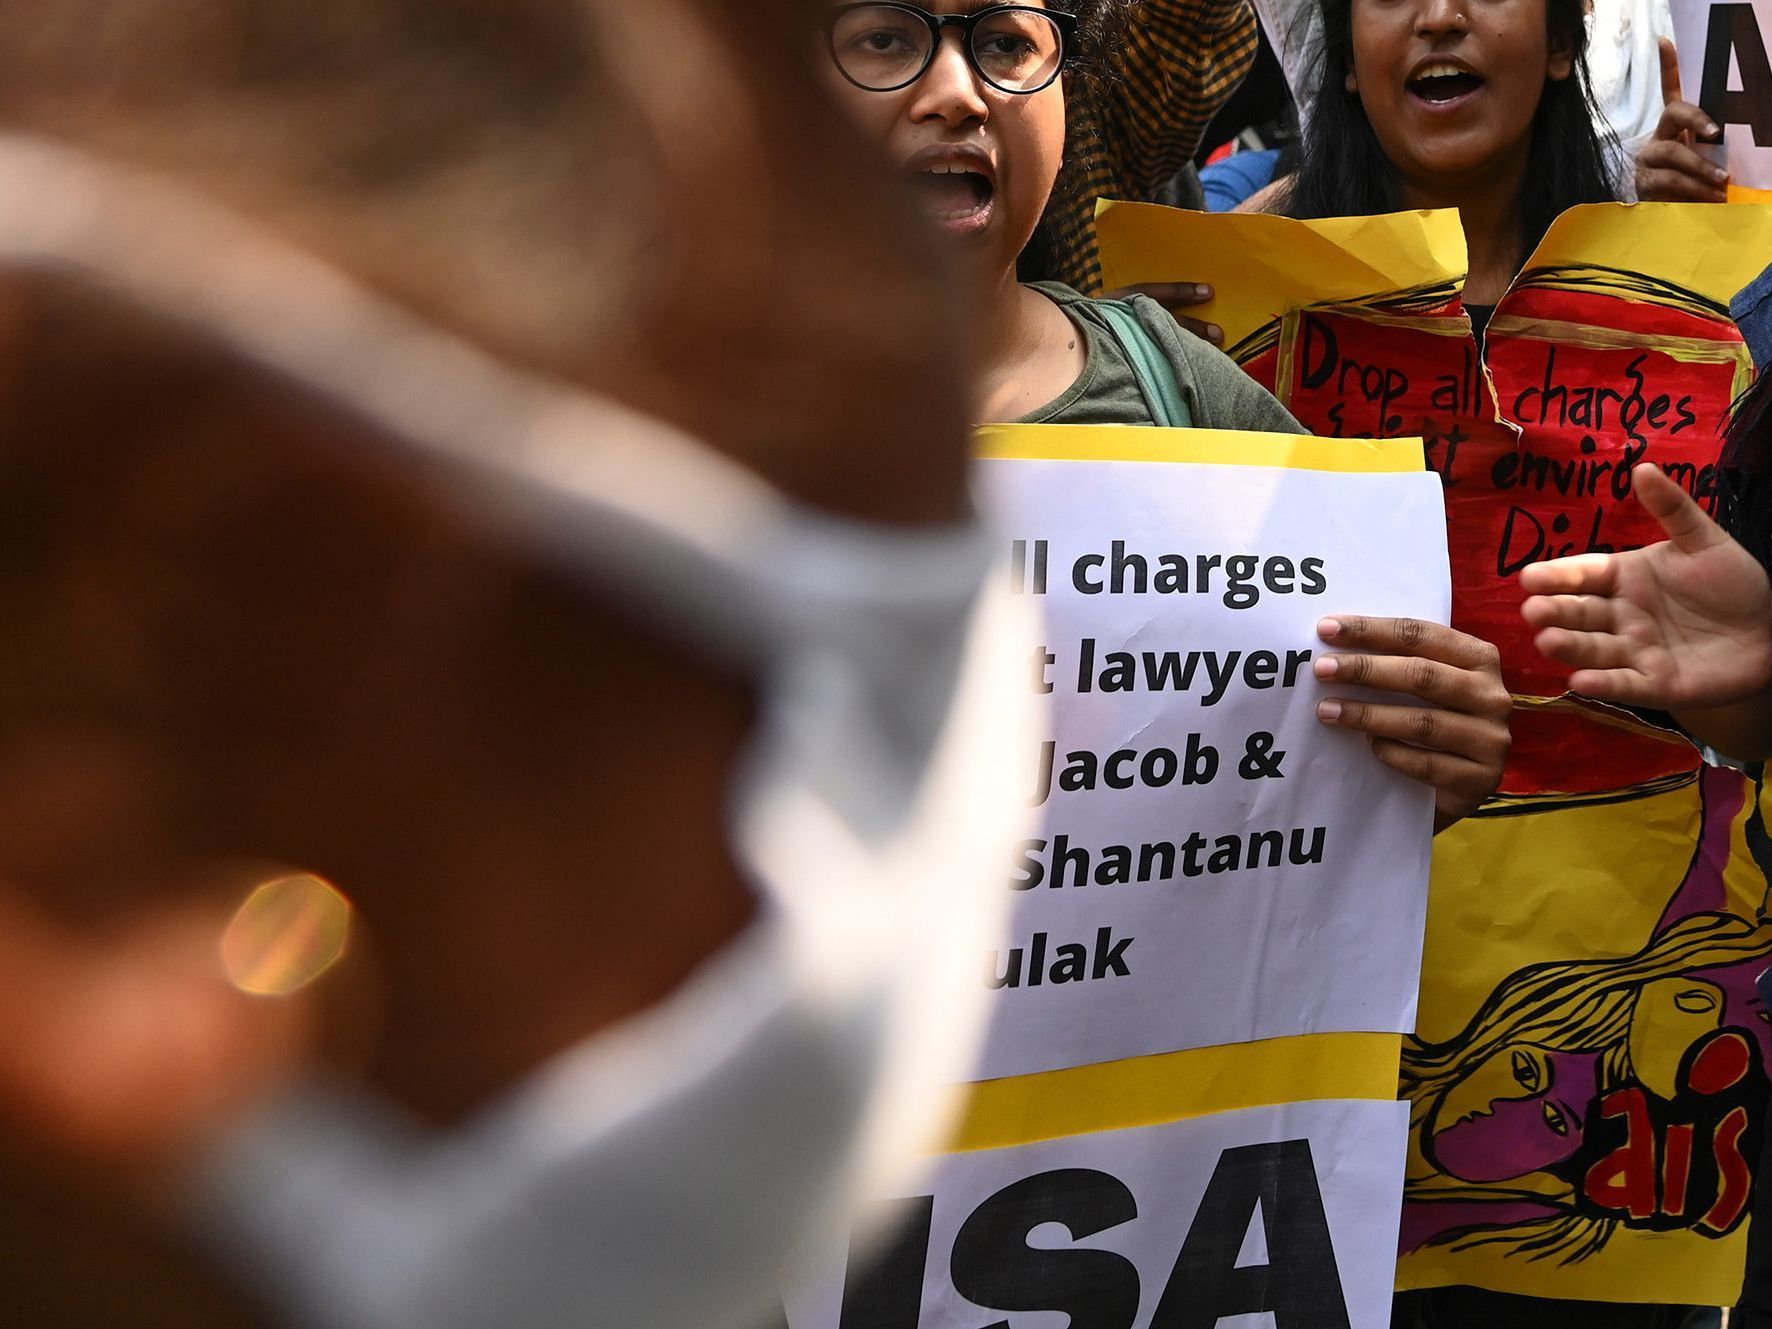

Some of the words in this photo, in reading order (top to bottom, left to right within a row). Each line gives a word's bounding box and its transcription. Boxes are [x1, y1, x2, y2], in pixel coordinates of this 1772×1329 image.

[1301, 312, 1408, 434] Drop
[1431, 336, 1487, 418] all
[1513, 345, 1697, 444] charges
[1010, 539, 1048, 595] ll
[1071, 540, 1327, 610] charges
[1077, 638, 1313, 707] lawyer
[1026, 730, 1220, 808] Jacob
[1237, 730, 1287, 781] &
[1007, 825, 1327, 892] Shantanu
[981, 926, 1136, 991] ulak
[838, 1138, 1352, 1329] ISA
